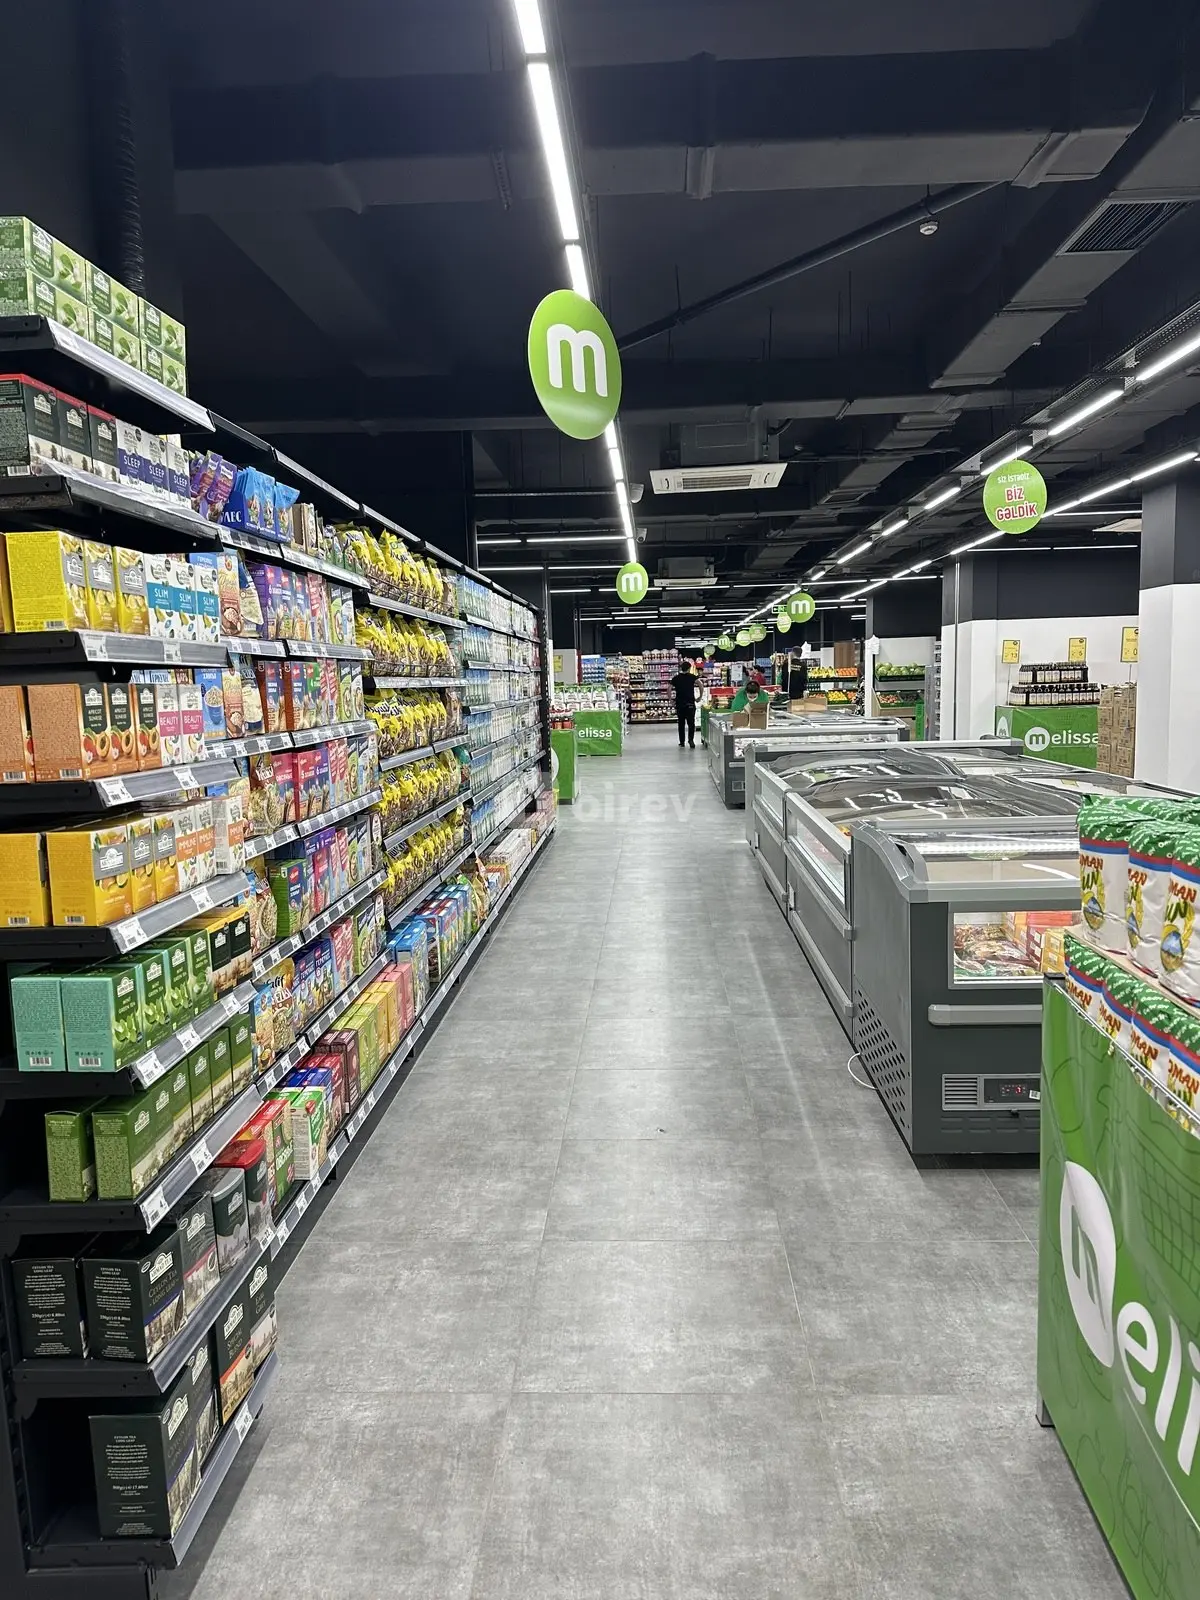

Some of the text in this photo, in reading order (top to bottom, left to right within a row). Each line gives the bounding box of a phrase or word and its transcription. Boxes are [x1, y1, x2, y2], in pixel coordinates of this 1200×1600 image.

[547, 323, 608, 397] m
[123, 455, 141, 468] SLEEP
[148, 465, 165, 478] SLEEP
[173, 474, 188, 488] SLEEP
[1006, 484, 1024, 501] BİZ
[996, 502, 1037, 520] GƏLDİK
[621, 571, 643, 593] m
[154, 588, 169, 598] SLIM
[179, 593, 192, 602] SLIM
[203, 597, 215, 606] SLIM
[791, 600, 811, 615] m
[1080, 853, 1104, 871] MAN
[1168, 879, 1198, 904] MAN
[1099, 1005, 1122, 1032] MAN
